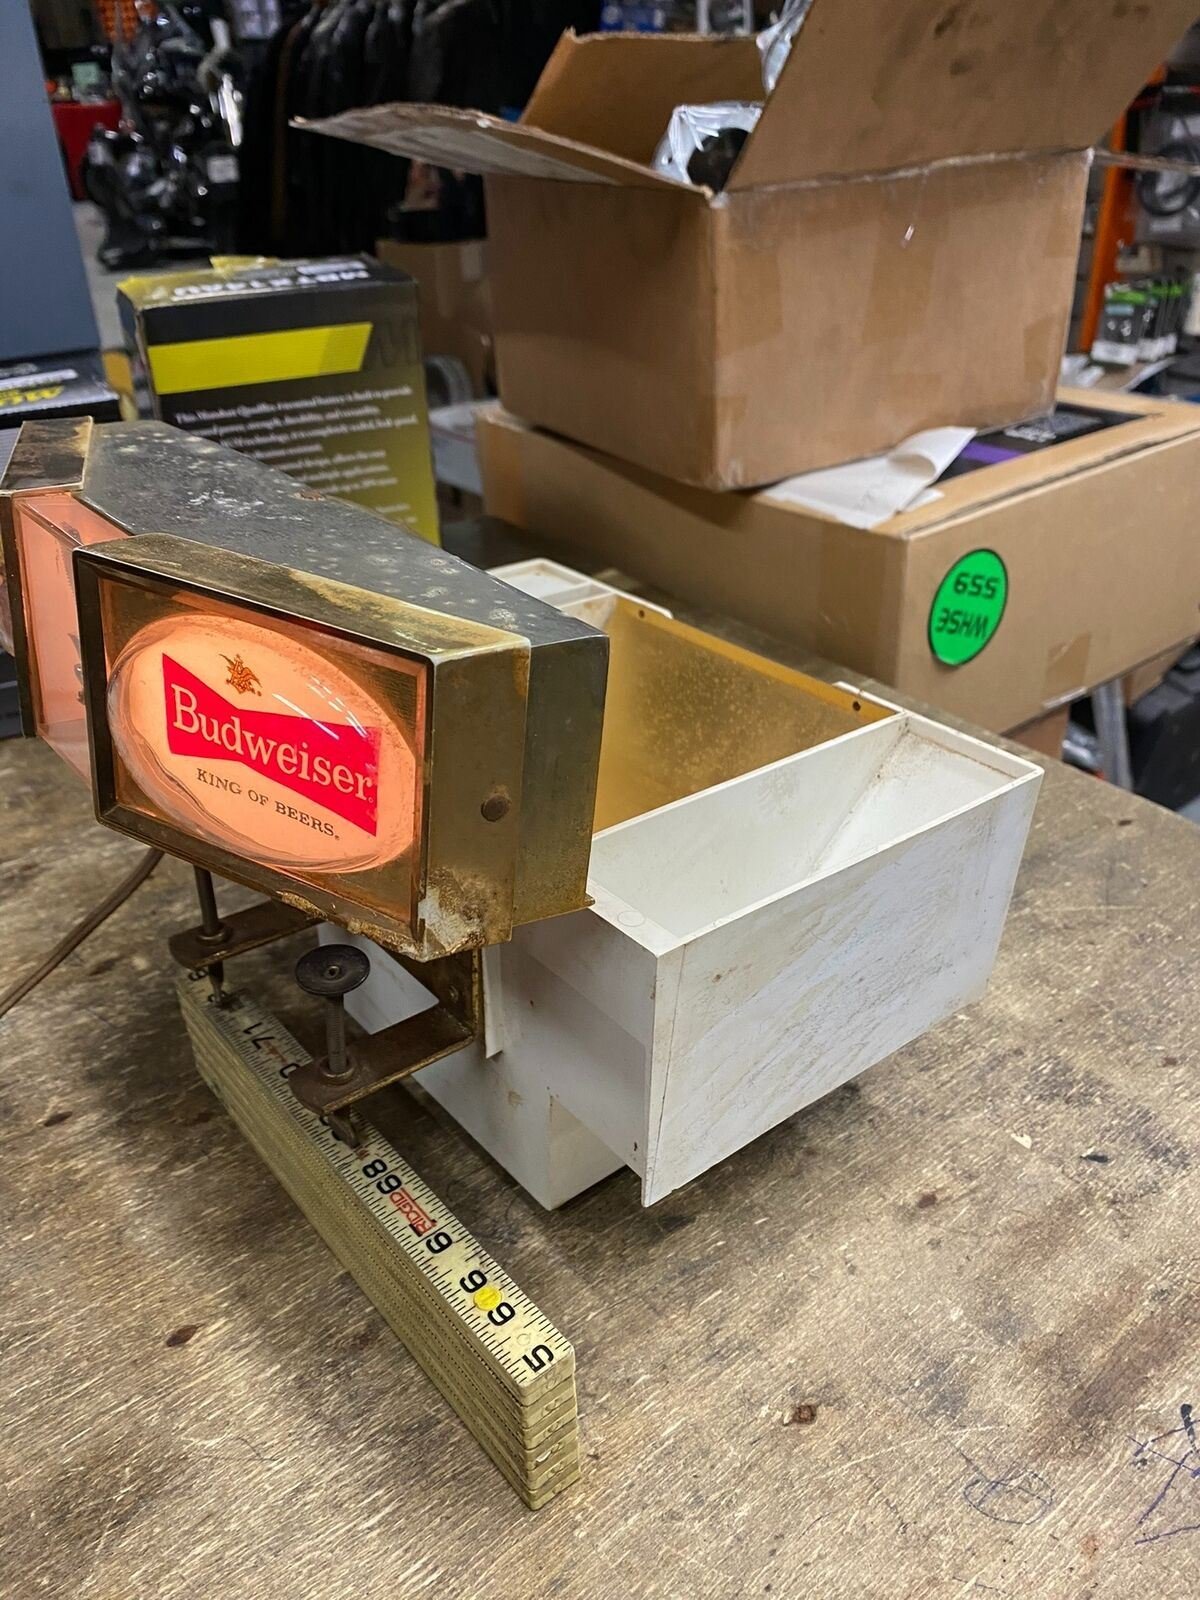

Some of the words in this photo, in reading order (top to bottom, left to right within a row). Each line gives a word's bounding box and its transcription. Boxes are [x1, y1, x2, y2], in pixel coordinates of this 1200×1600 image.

[954, 572, 1000, 600] 559
[935, 607, 988, 638] WHSE
[197, 767, 242, 794] KING
[248, 789, 269, 806] OF
[389, 1189, 434, 1235] RIDGID
